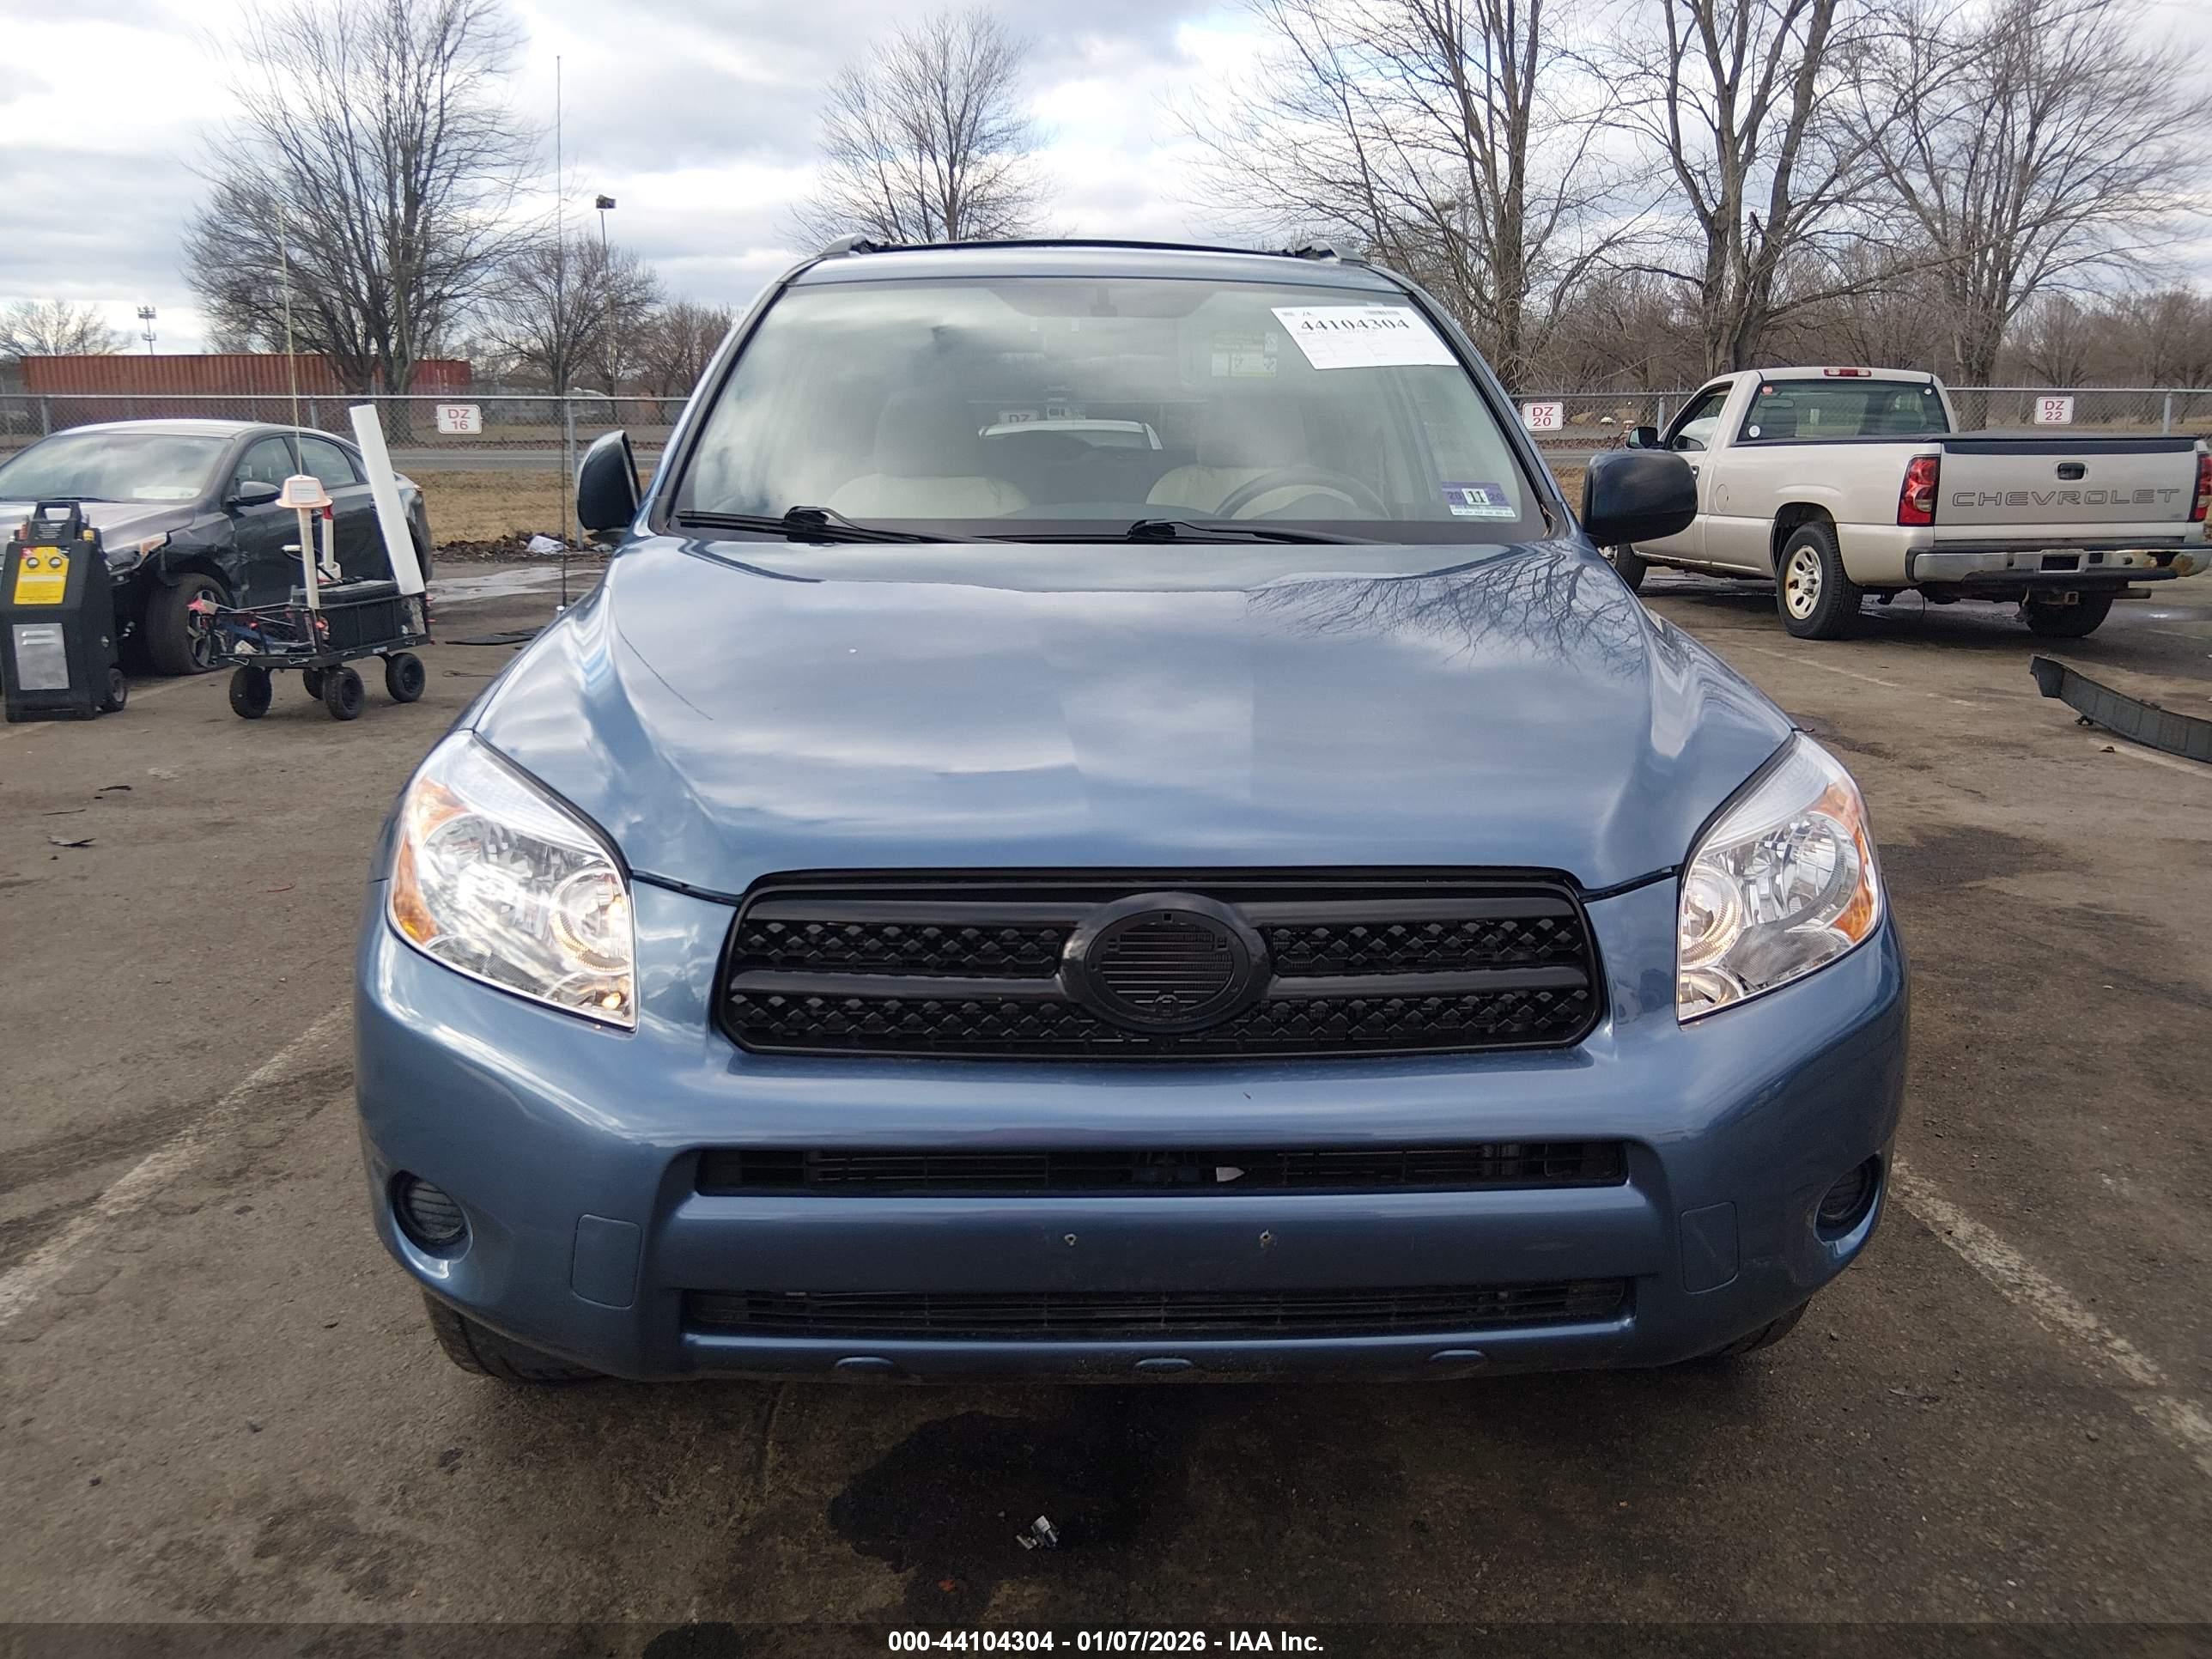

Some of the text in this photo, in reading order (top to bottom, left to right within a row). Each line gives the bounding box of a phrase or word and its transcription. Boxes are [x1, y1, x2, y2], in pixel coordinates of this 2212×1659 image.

[1301, 319, 1409, 331] 44104304
[2045, 400, 2064, 410] DZ
[447, 409, 470, 419] DZ
[1532, 406, 1553, 416] DZ
[2045, 411, 2063, 421] 22
[451, 420, 468, 430] 16
[1533, 416, 1552, 427] 20
[1468, 490, 1486, 503] 11
[1952, 489, 2180, 507] CHEVROLET
